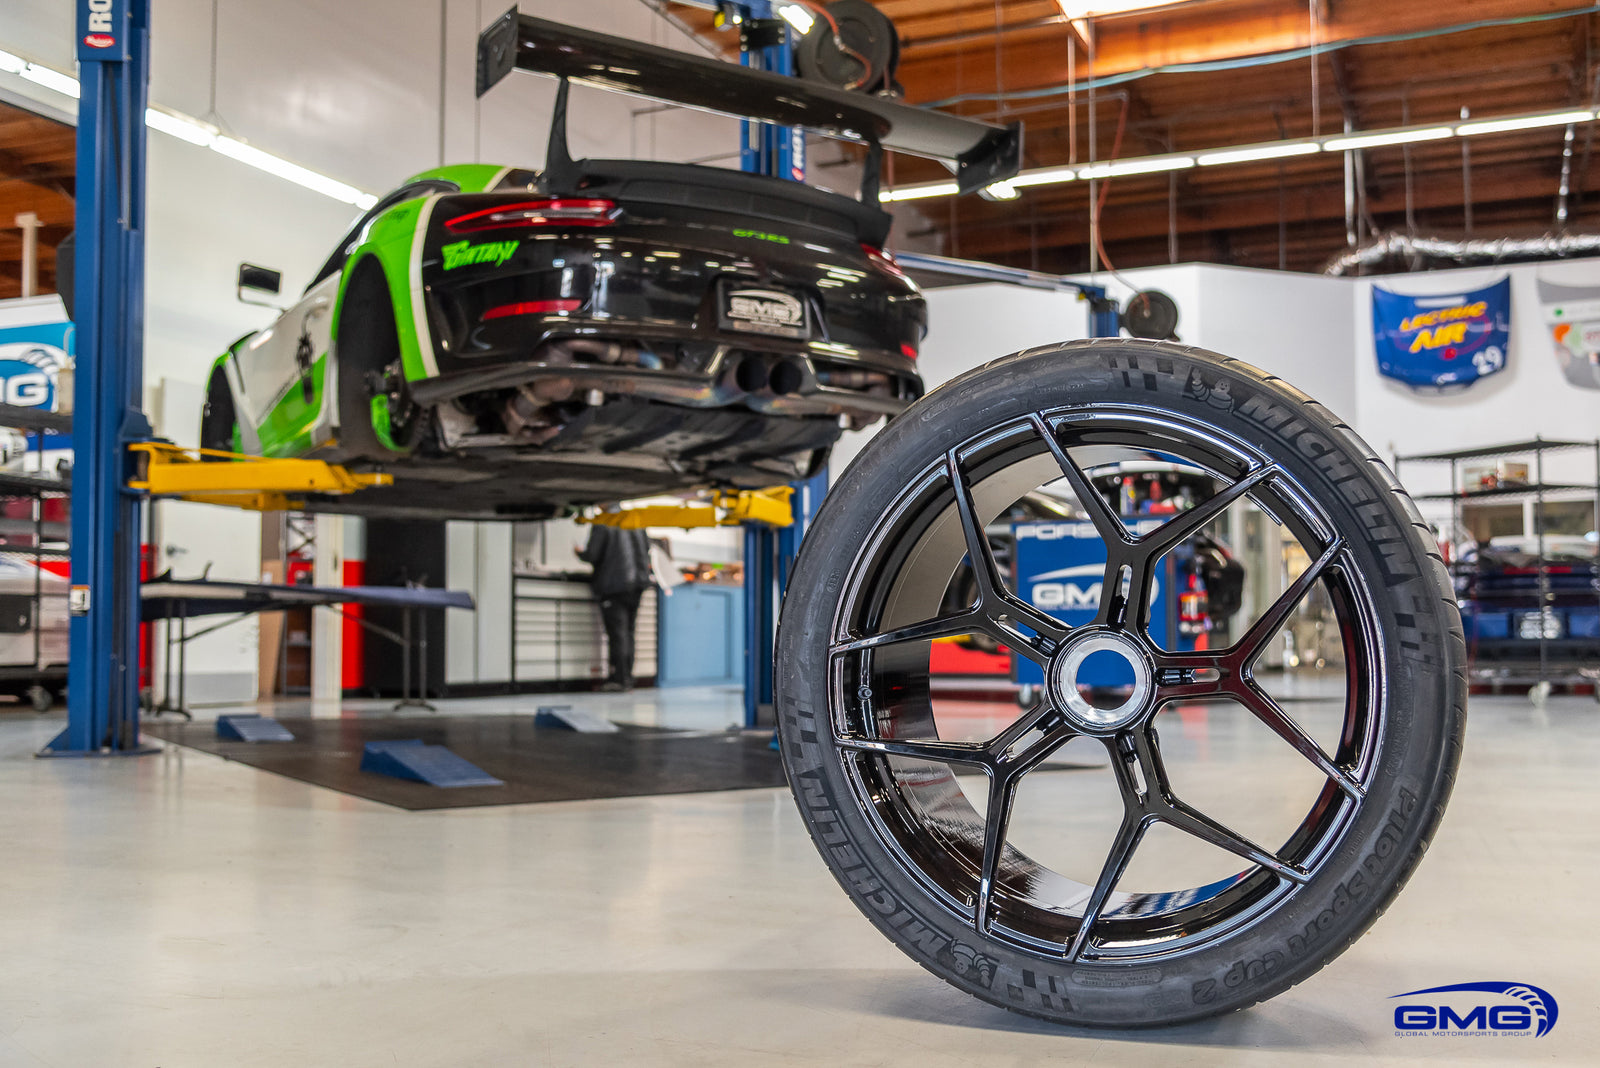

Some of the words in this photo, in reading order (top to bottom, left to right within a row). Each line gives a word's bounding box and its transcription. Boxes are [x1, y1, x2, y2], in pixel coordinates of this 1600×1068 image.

[1472, 346, 1502, 375] 29
[1238, 394, 1422, 577] MICHELIN
[800, 774, 949, 961] MICHELIN
[1287, 871, 1370, 953] Sport
[1223, 949, 1284, 989] Cup
